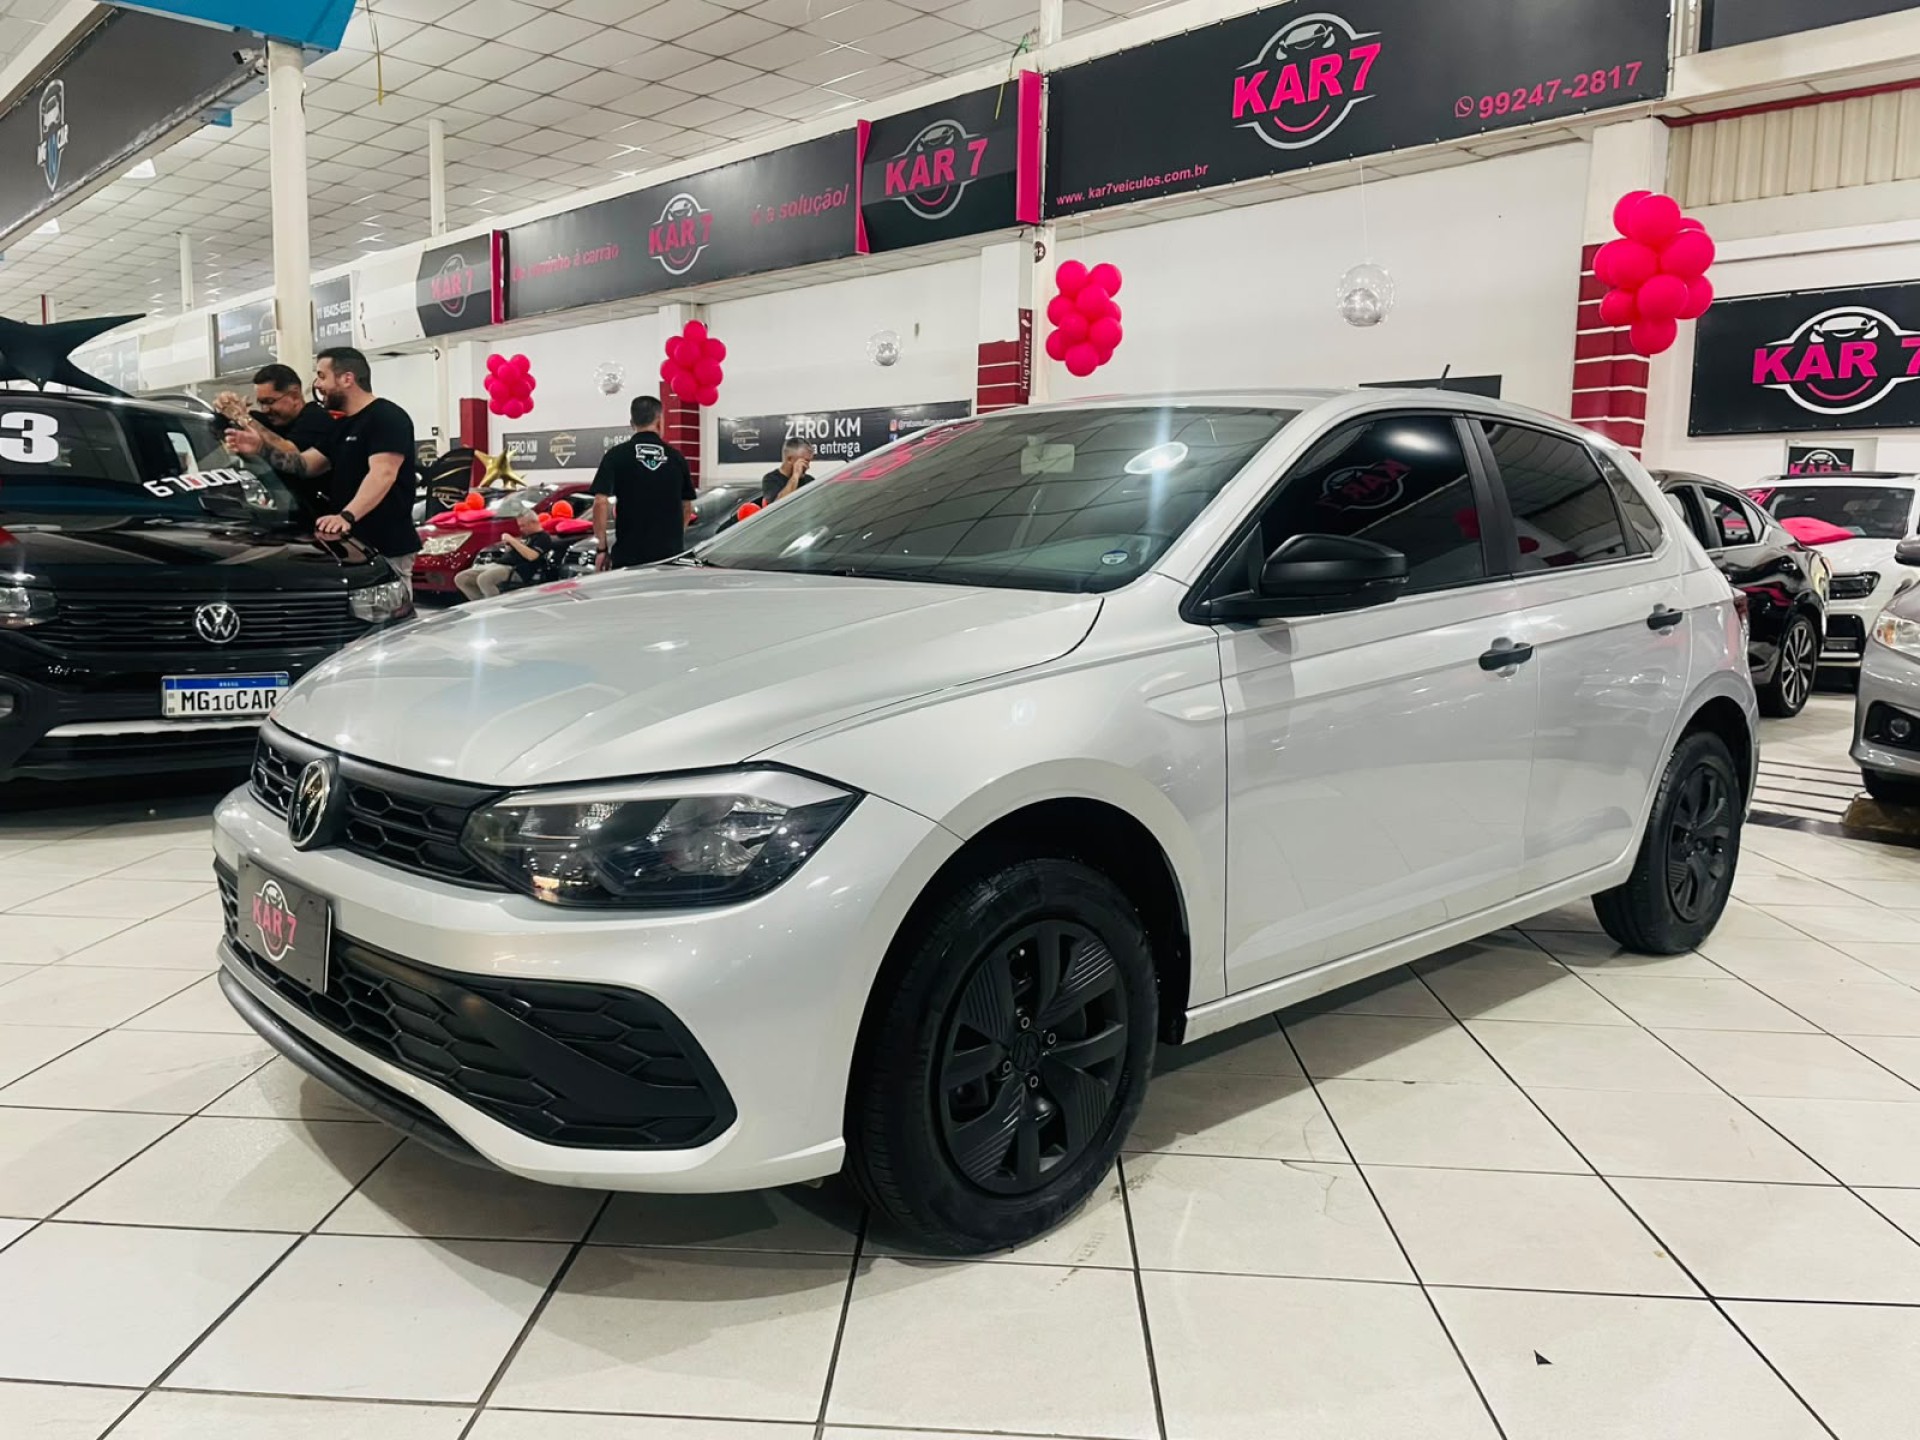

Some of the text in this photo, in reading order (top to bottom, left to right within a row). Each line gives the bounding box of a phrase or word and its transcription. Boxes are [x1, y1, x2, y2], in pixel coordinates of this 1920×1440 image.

[1478, 61, 1643, 119] 99247-2817
[884, 137, 989, 196] KAR 7
[1088, 164, 1209, 199] kar7veiculos.com.br
[779, 184, 850, 220] solução!
[648, 212, 714, 256] KAR 7
[431, 272, 462, 301] KAR
[1752, 337, 1920, 384] KAR 7
[784, 416, 862, 440] ZERO KM
[820, 440, 861, 457] entrega
[181, 690, 277, 712] MG10CAR
[252, 894, 298, 945] KAR 7
